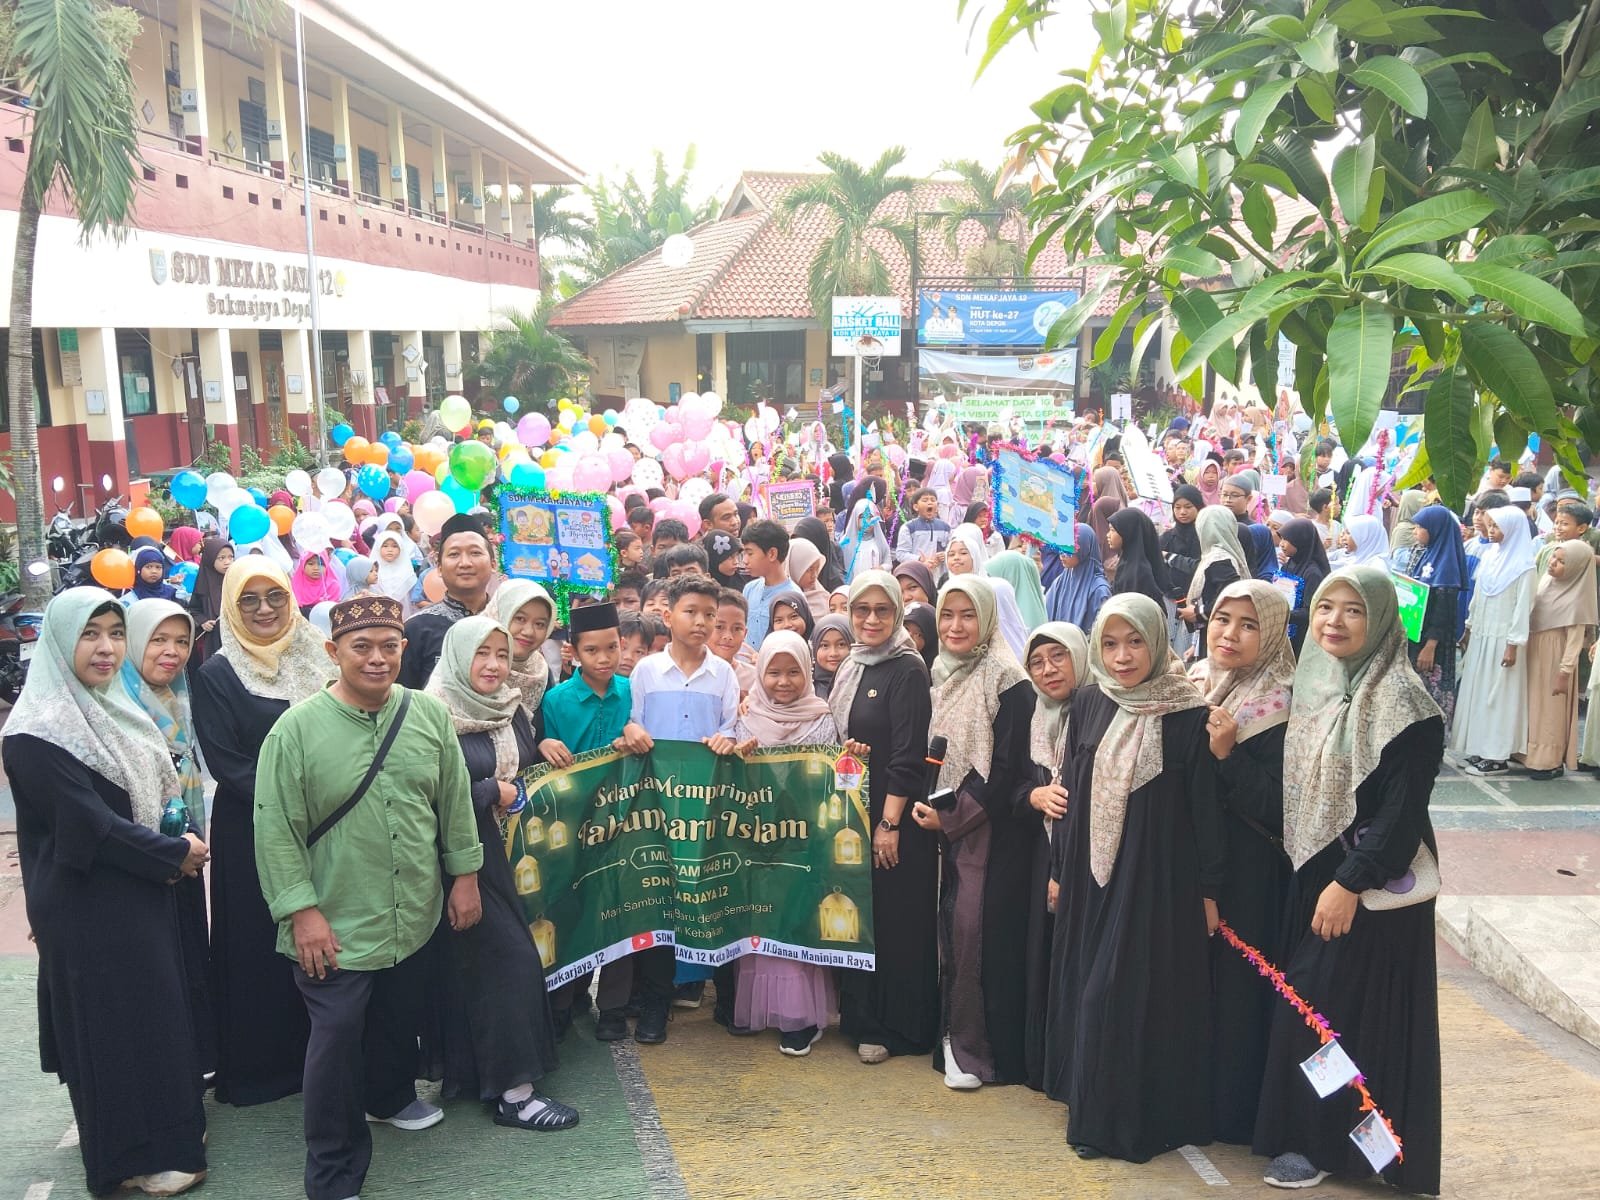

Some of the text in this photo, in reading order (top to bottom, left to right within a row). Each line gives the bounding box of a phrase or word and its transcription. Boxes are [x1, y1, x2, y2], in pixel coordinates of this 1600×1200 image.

[171, 252, 211, 284] SDN
[215, 257, 279, 291] MEKAR
[207, 292, 312, 324] Sukmajaya Depo
[970, 310, 1019, 319] HUT ke-27
[833, 315, 872, 328] BASKET
[966, 399, 1051, 407] SELAMAT DATAG
[721, 810, 809, 844] Islam
[723, 858, 731, 869] H
[642, 876, 670, 888] SDN
[718, 885, 729, 898] 12
[623, 895, 666, 912] Sambut
[655, 933, 673, 944] SDN
[696, 952, 706, 962] 12
[801, 950, 844, 965] Maninjau
